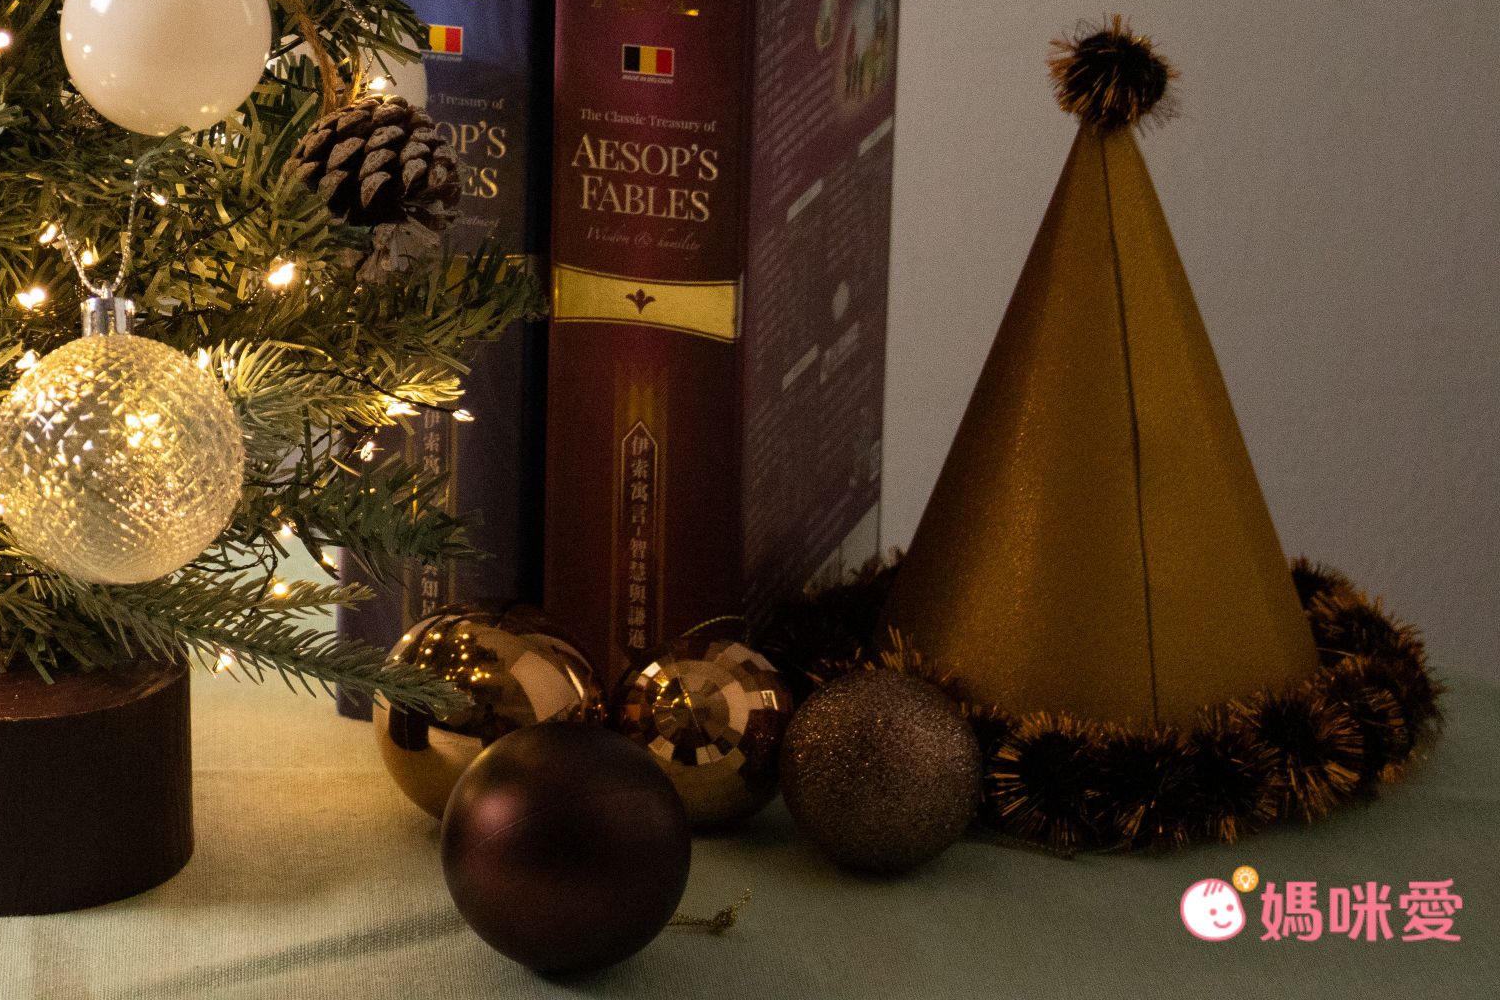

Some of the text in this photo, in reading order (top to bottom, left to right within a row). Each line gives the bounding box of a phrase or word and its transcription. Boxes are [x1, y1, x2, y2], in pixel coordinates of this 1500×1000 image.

[433, 120, 509, 159] OP'S
[579, 108, 717, 133] The Classic Treasury of
[571, 132, 720, 181] AESOP'S
[580, 174, 711, 223] FABLES
